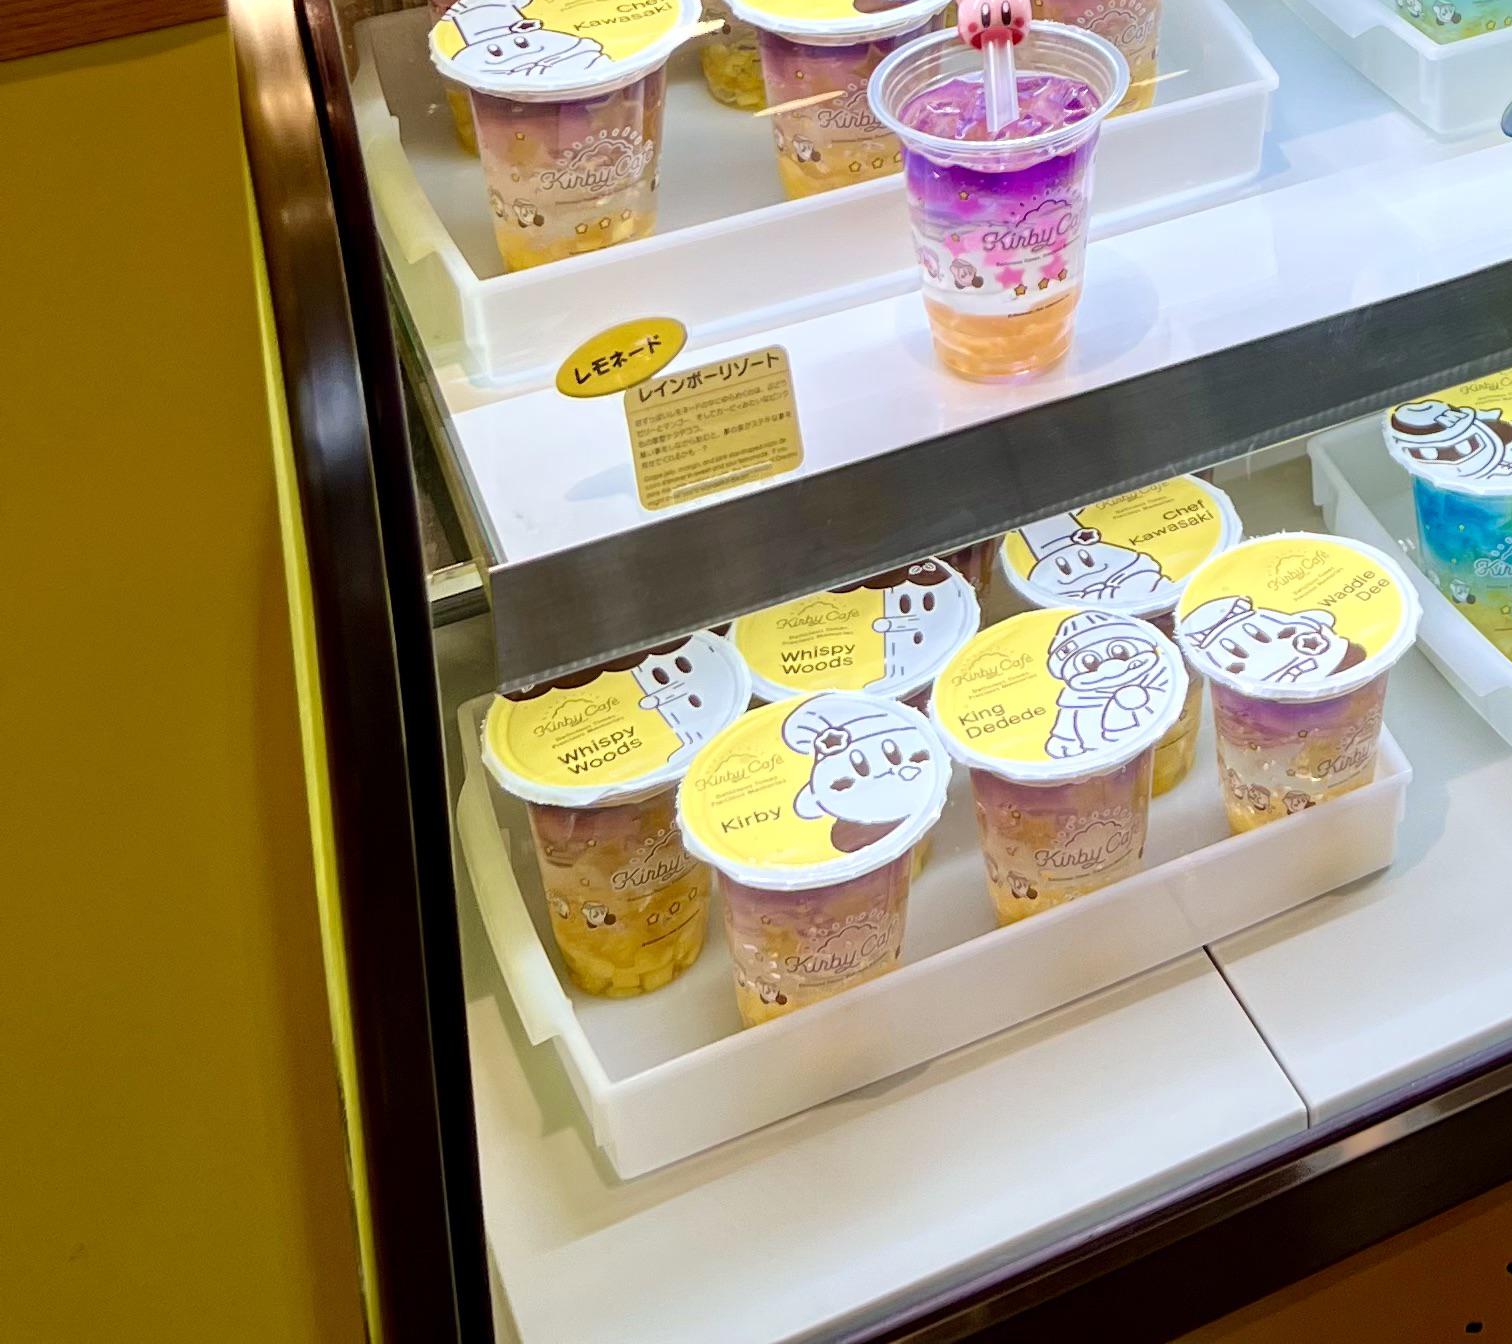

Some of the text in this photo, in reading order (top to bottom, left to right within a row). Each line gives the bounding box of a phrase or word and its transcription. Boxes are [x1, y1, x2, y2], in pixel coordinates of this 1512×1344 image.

[573, 2, 673, 31] Kawasaki
[540, 167, 614, 192] Kirby
[982, 228, 1057, 253] Kirby
[574, 334, 662, 386] レモネード
[638, 352, 780, 403] レインボーリゾート
[1162, 499, 1206, 520] Chef
[1128, 509, 1214, 546] Kawasaki
[1317, 570, 1376, 607] Waddle
[1355, 578, 1391, 602] Dee
[781, 644, 856, 663] Whispy
[782, 656, 854, 675] Woods
[959, 704, 1005, 726] King
[966, 707, 1047, 739] Dedede
[557, 725, 635, 765] Whispy
[567, 738, 643, 775] Woods
[721, 806, 781, 833] Kirby
[1034, 846, 1107, 870] Kirby
[611, 853, 686, 891] Kirby
[784, 949, 861, 974] Kirby
